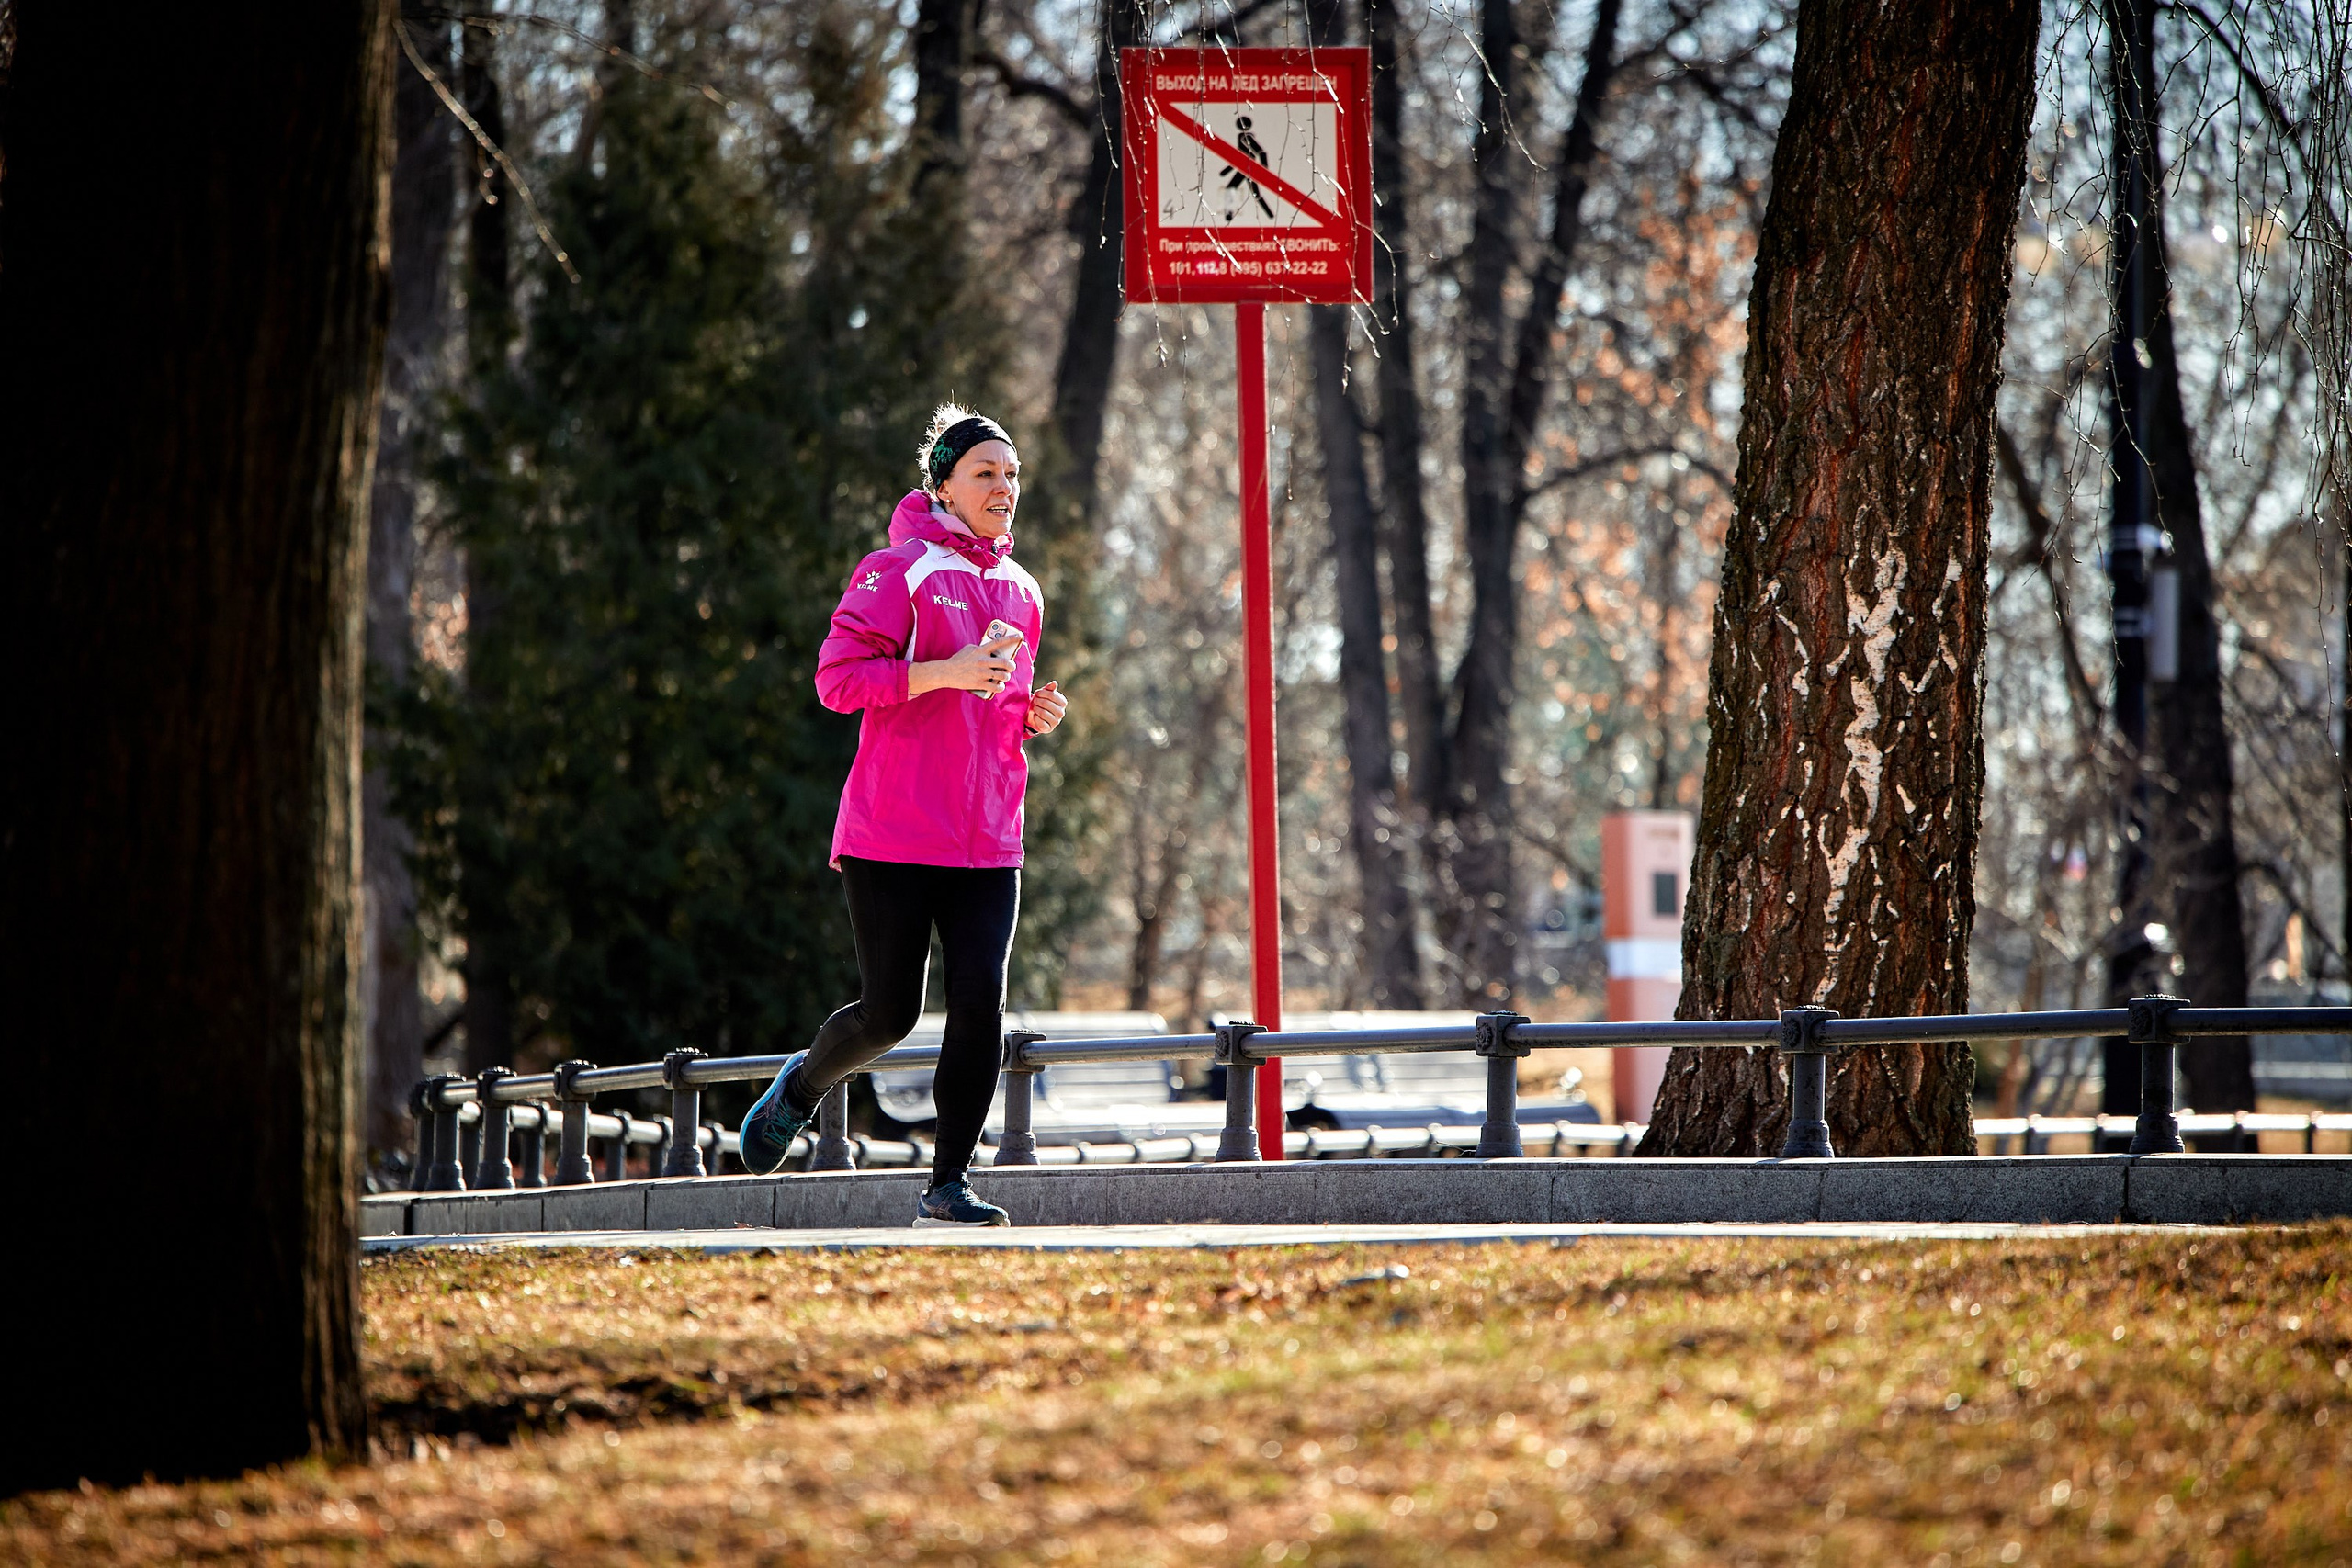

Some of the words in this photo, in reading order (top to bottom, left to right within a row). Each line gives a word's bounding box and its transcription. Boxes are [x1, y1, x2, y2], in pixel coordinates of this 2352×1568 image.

[1156, 74, 1206, 93] ВЫХОД
[1209, 75, 1228, 91] НА
[1231, 74, 1259, 93] ЛЕД
[1159, 238, 1183, 254] При
[1185, 241, 1277, 254] проишествиях
[933, 595, 968, 611] KELME
